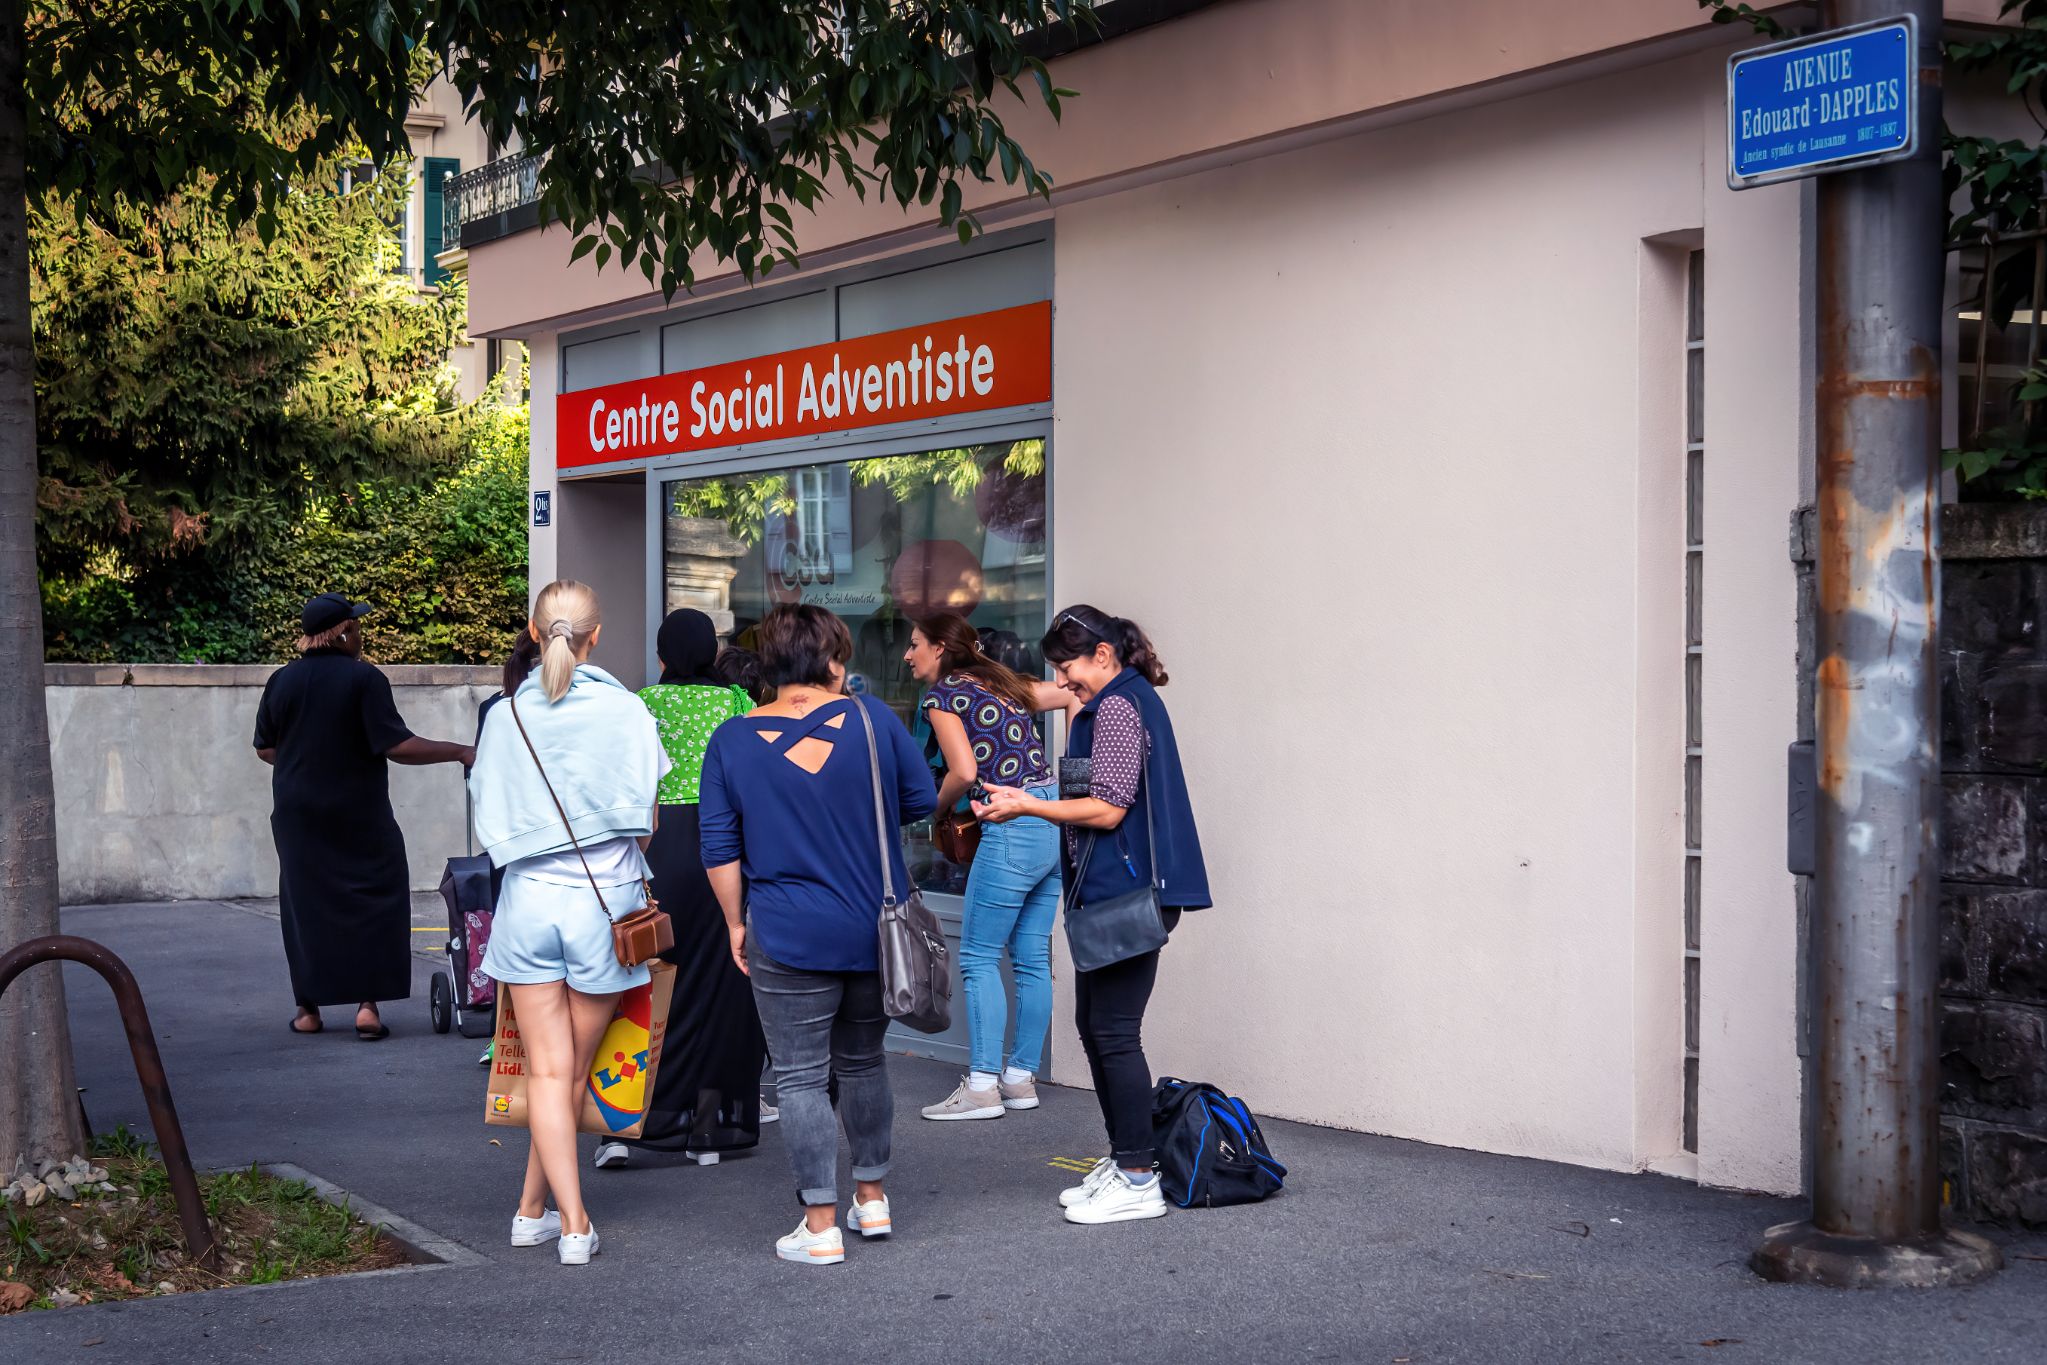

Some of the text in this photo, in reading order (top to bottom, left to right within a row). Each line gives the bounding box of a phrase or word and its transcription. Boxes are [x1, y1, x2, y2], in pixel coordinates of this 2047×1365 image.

[1783, 48, 1852, 93] AVENUE
[1743, 150, 1767, 164] Ancien
[1770, 142, 1794, 161] syndic
[1797, 140, 1807, 153] de
[1810, 134, 1847, 151] Lausanne
[589, 334, 995, 452] Centre Social Adventiste
[496, 1062, 525, 1076] Lidl.
